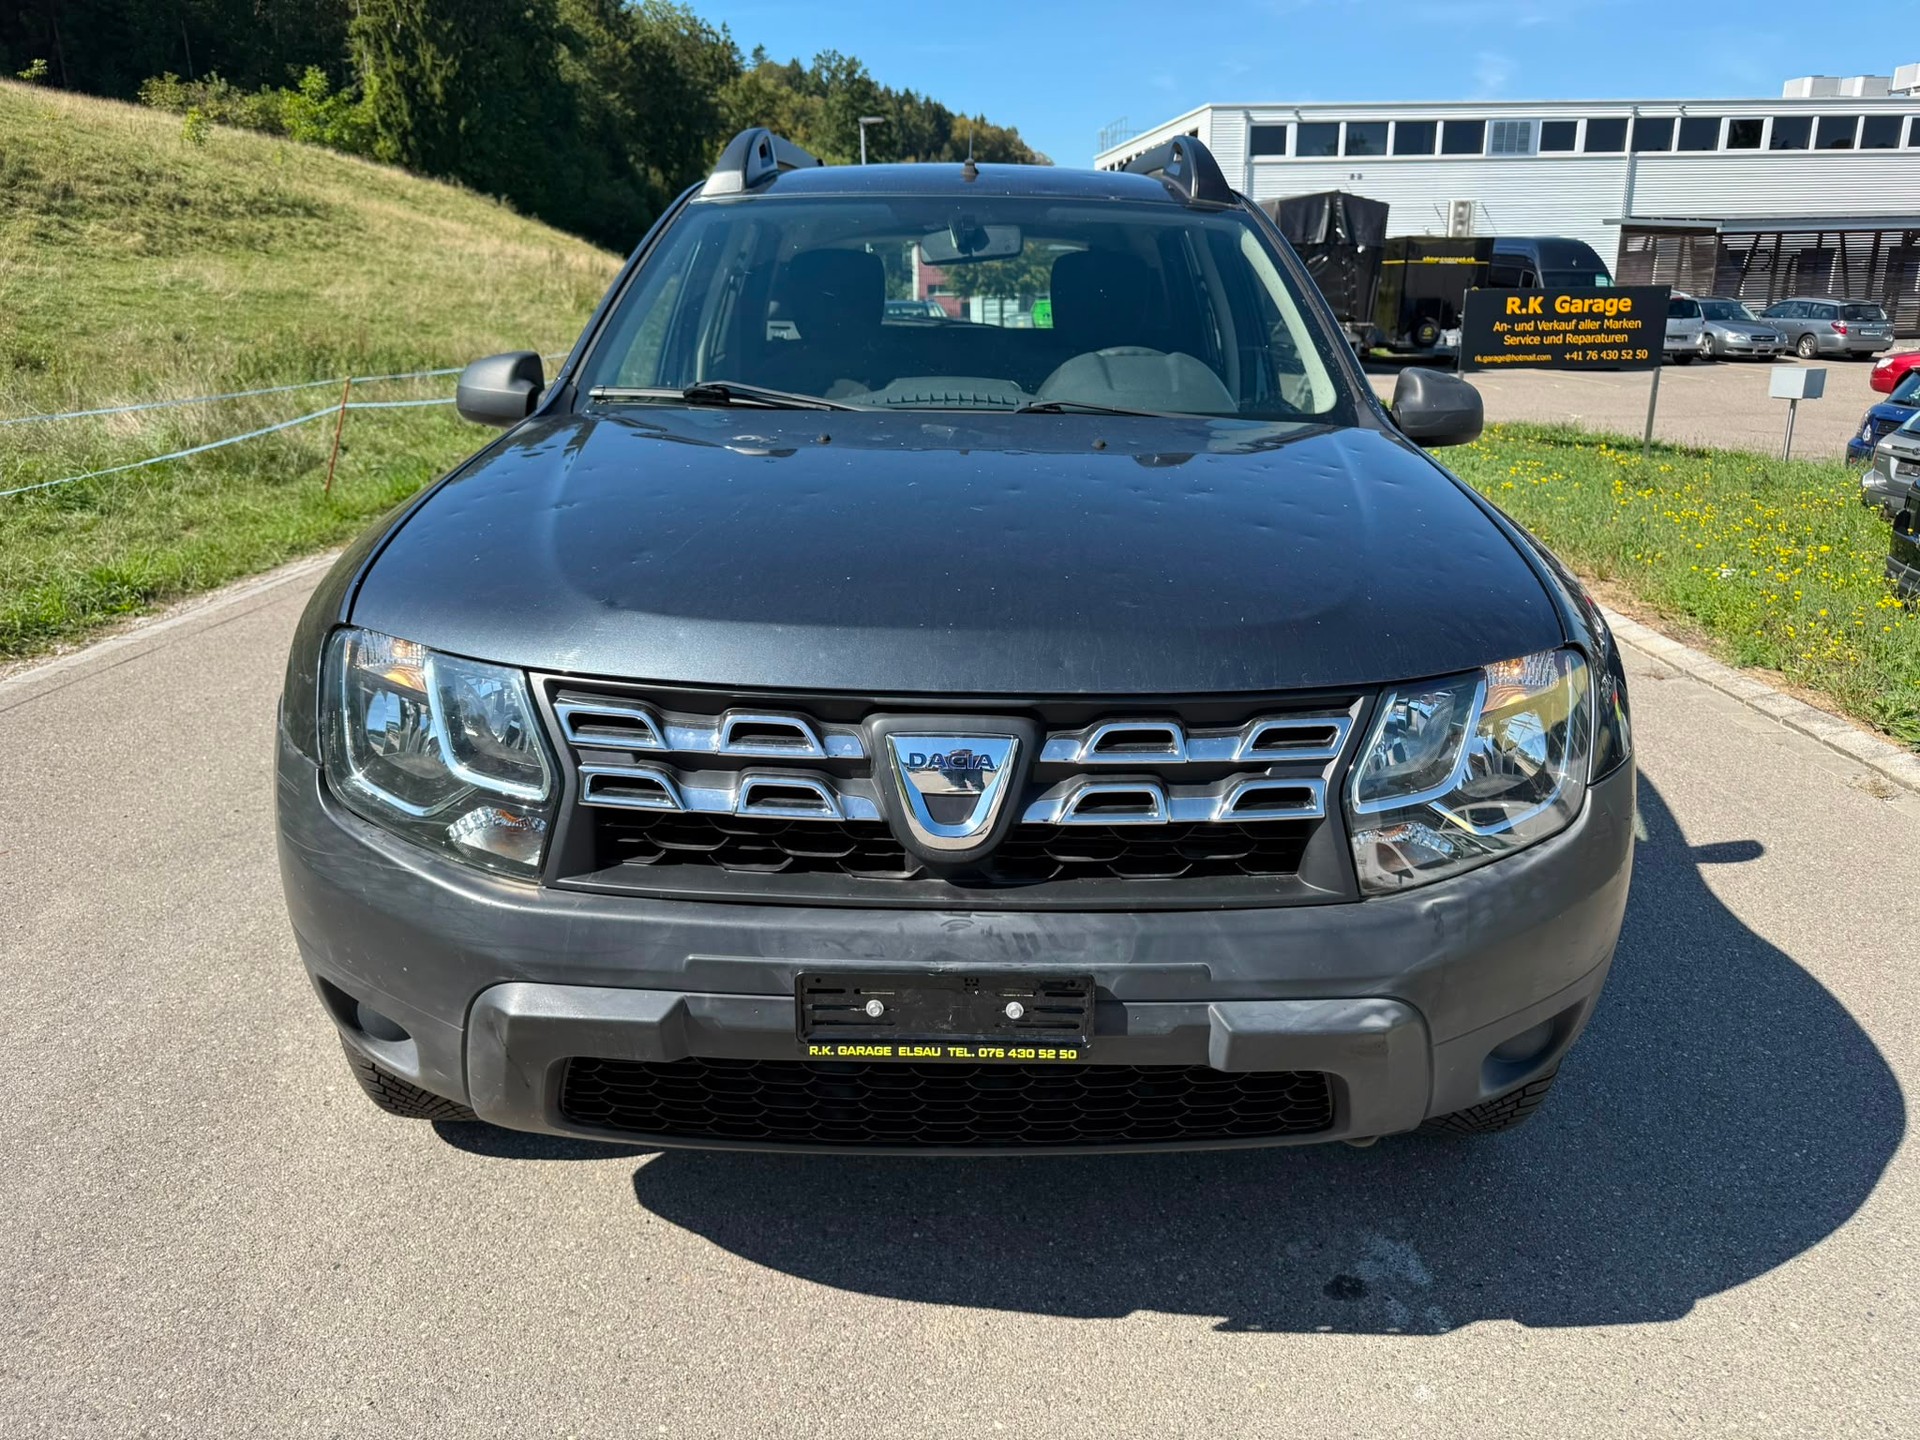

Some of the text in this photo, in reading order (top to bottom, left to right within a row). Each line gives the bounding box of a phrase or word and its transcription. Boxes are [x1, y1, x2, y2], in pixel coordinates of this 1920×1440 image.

[1506, 295, 1632, 316] R.K Garage
[1493, 318, 1641, 332] An- und Verkauf aller Marken
[1504, 333, 1628, 346] Service und Reparaturen
[1564, 349, 1648, 361] +41 76 430 52 50
[908, 752, 996, 770] DACIA
[809, 1045, 1077, 1060] R.K. GARAGE ELSAU TEL. 076 430 52 50
